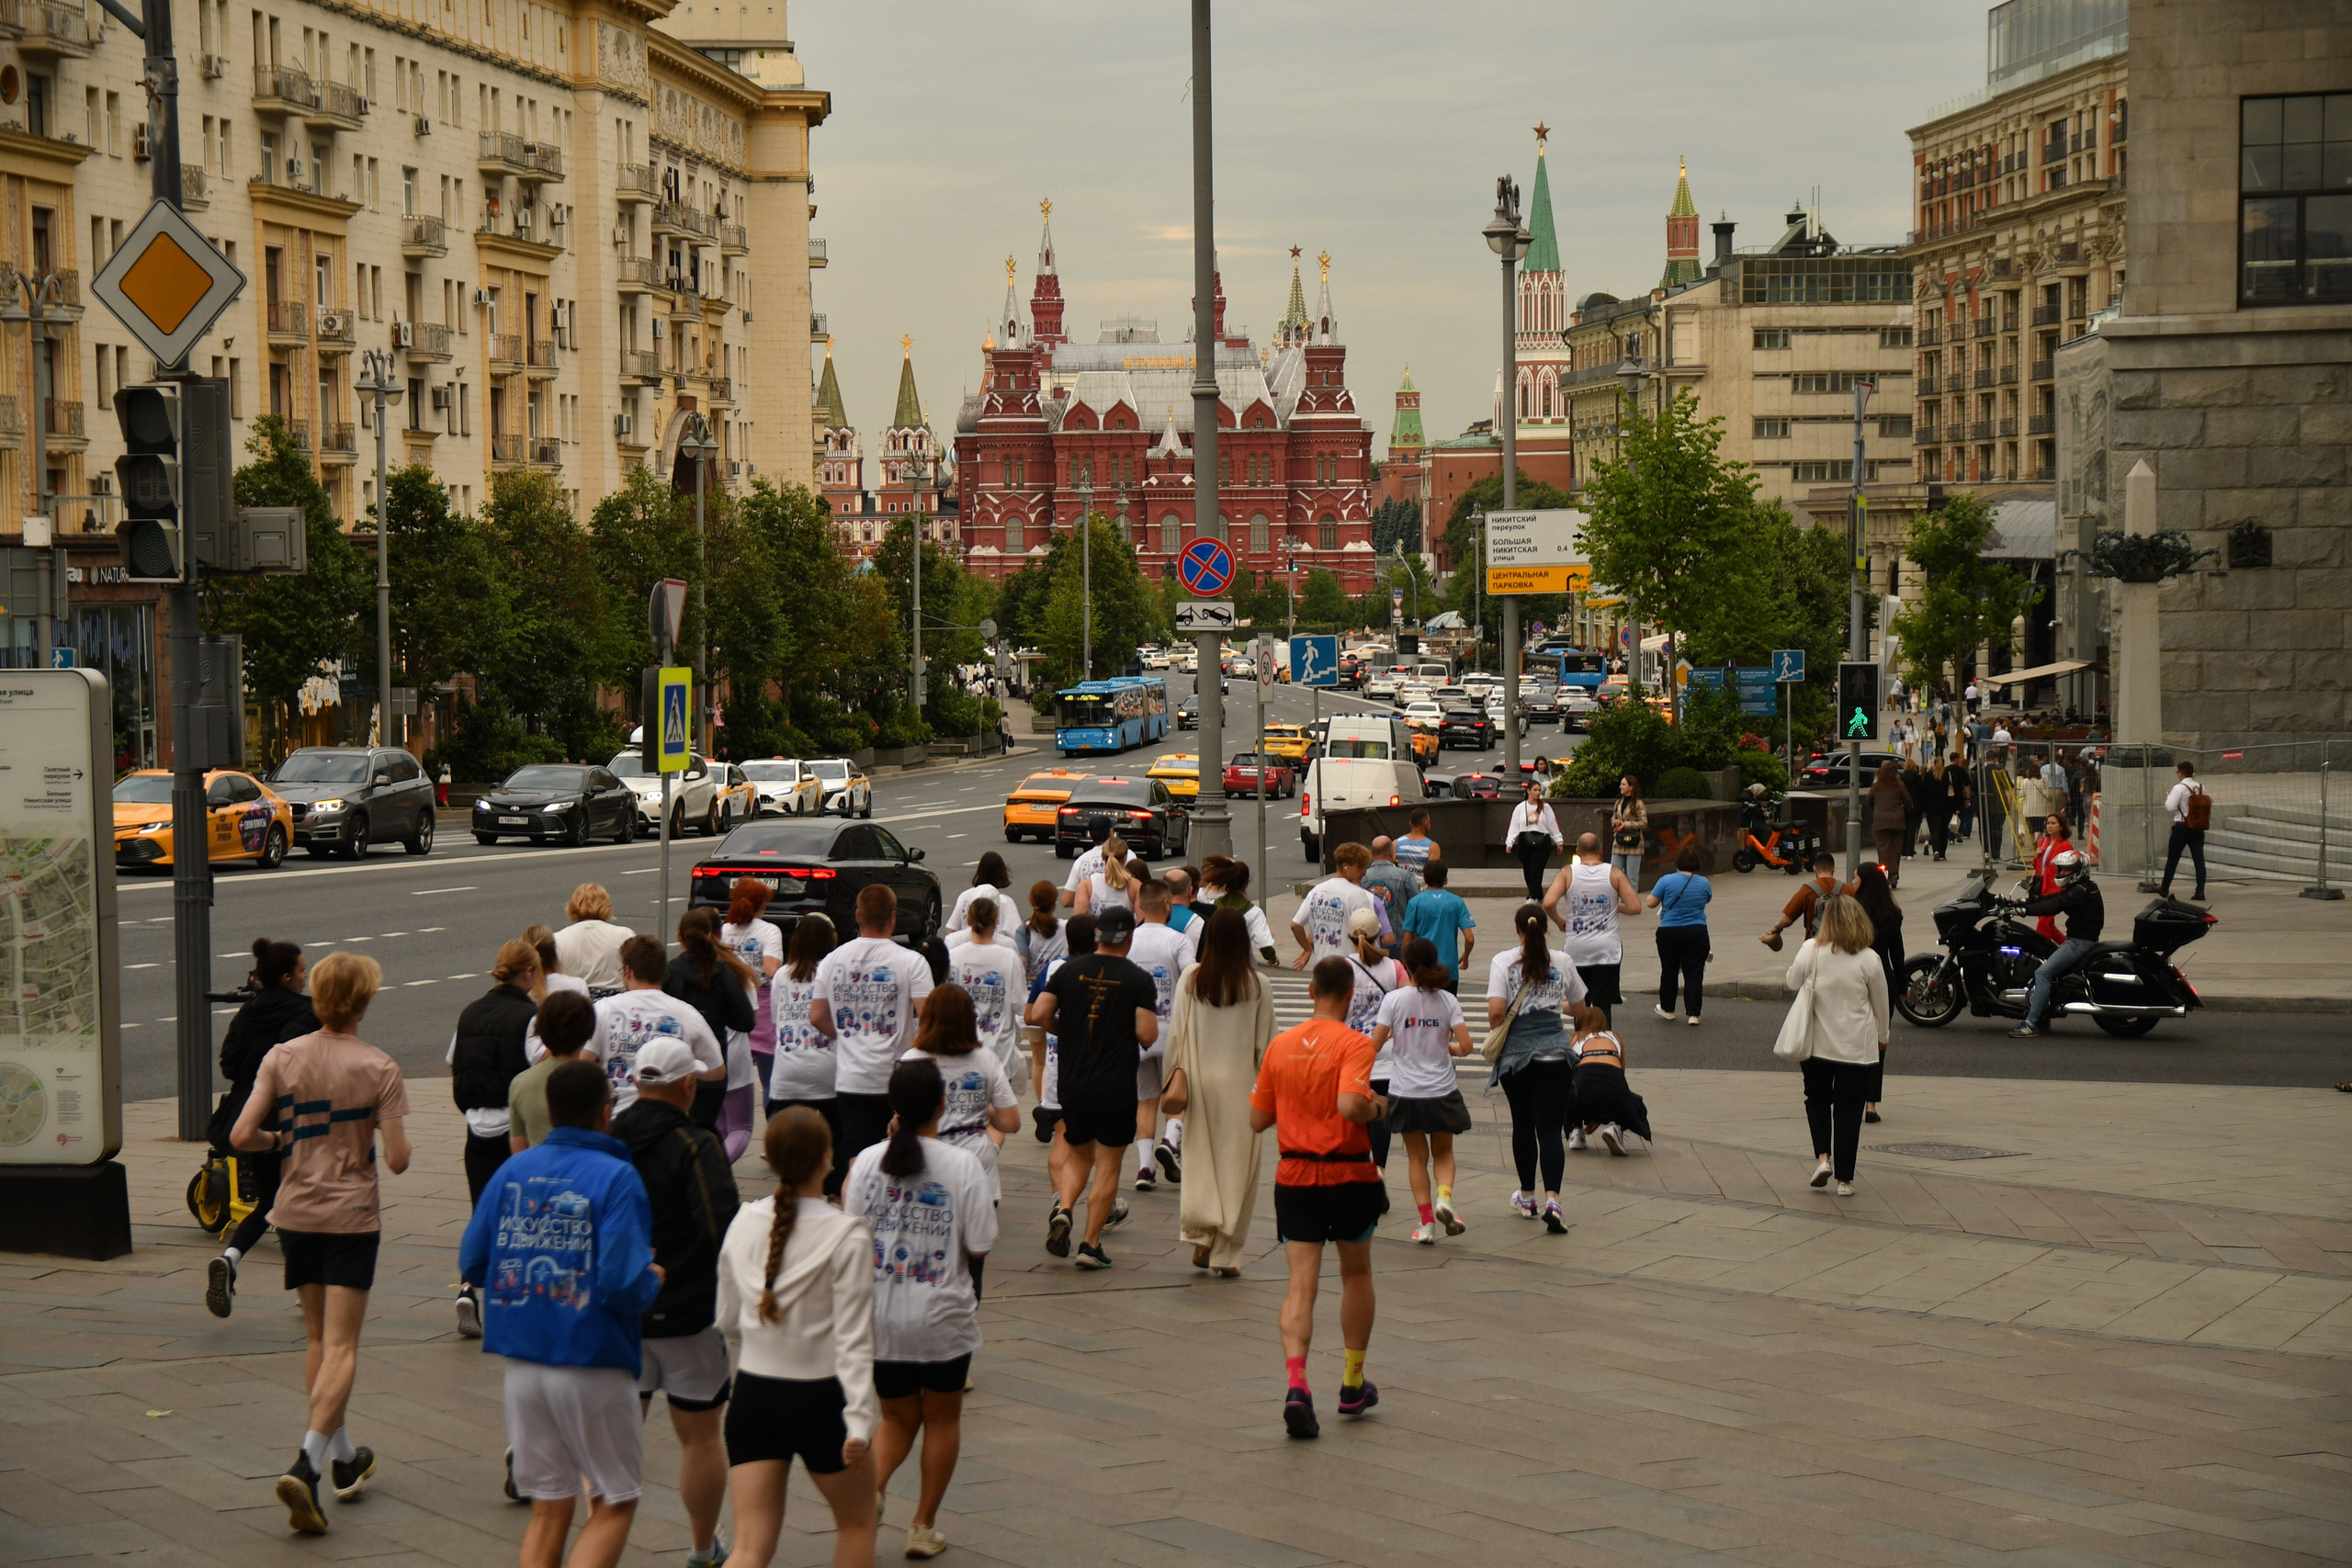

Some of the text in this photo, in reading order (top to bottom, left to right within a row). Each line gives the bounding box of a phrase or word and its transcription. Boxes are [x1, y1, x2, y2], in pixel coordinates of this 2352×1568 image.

[1491, 514, 1537, 524] НИКИТСКИЙ
[1492, 546, 1538, 554] НИКИТСКАЯ
[100, 567, 127, 583] NATUR
[1492, 570, 1549, 580] ЦЕНТРАЛЬНАЯ
[1263, 661, 1269, 675] 50
[8, 689, 34, 697] улица
[833, 993, 898, 1002] В ДВИЖЕНИИ
[973, 994, 1004, 1004] ЖЕНИИ
[1418, 1018, 1440, 1027] ПСБ
[947, 1091, 988, 1103] ССТВО
[499, 1215, 593, 1235] ИСКУССТВО
[496, 1232, 593, 1250] В ДВИЖЕНИИ
